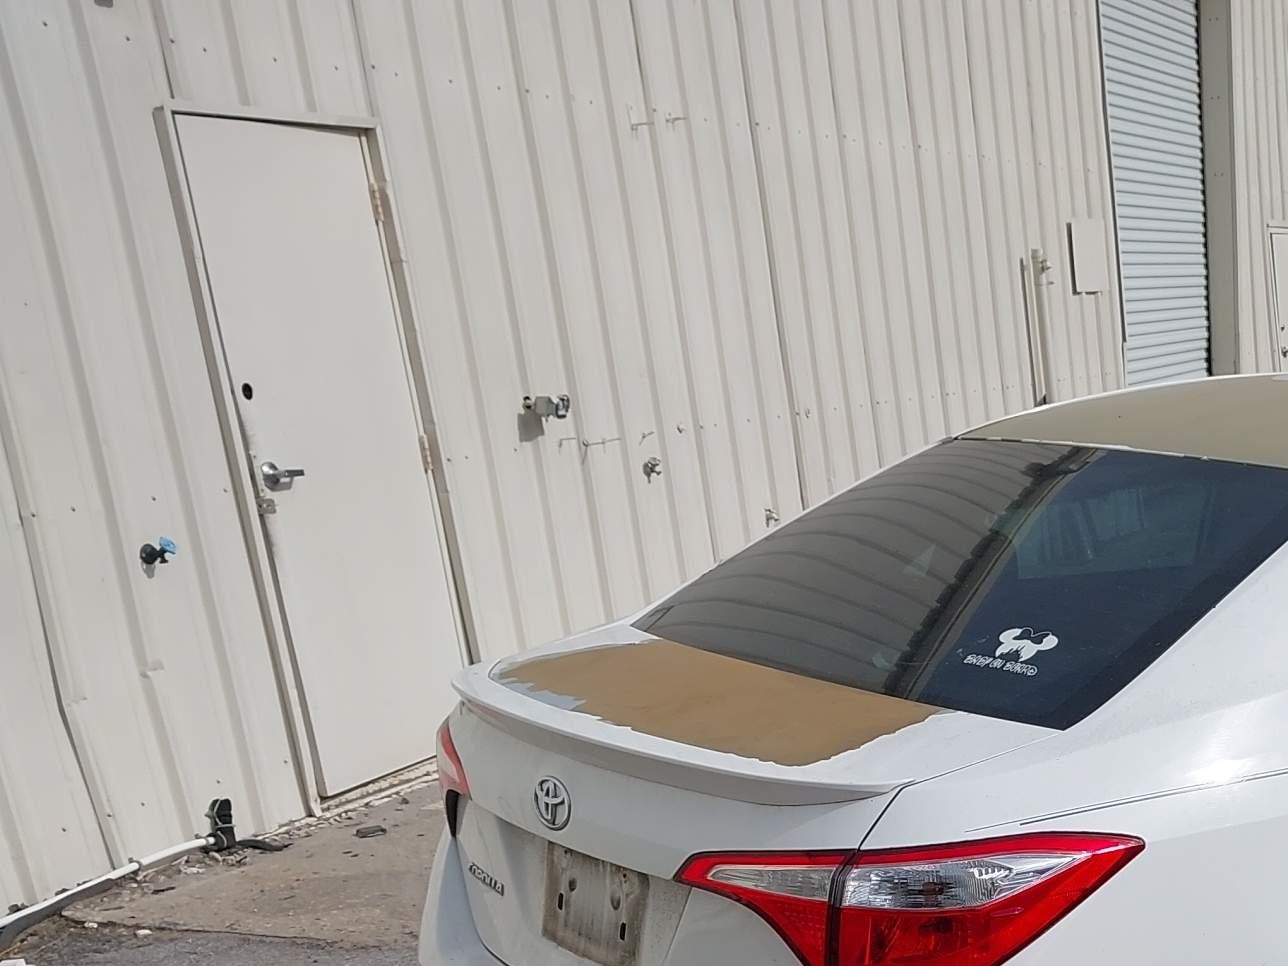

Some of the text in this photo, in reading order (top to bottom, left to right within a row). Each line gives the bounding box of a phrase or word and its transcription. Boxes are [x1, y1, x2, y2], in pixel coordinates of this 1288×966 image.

[963, 654, 1039, 676] BABY ON BOARD
